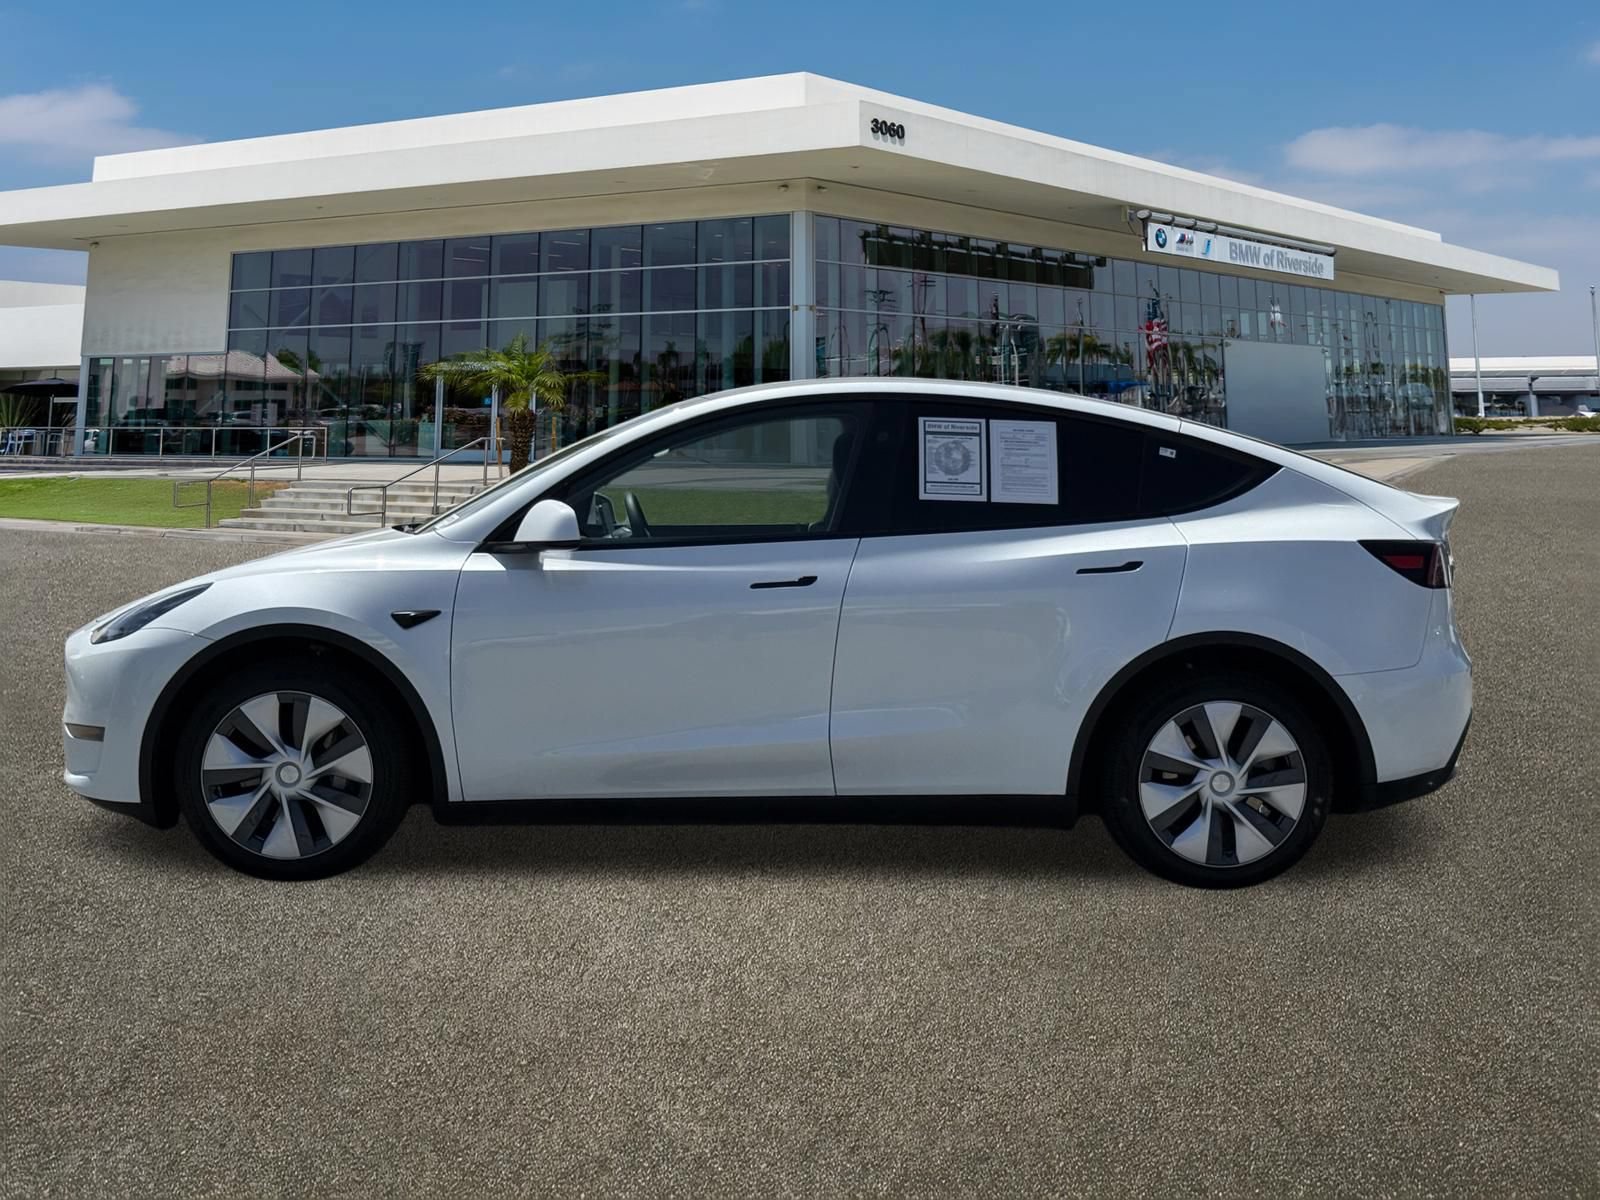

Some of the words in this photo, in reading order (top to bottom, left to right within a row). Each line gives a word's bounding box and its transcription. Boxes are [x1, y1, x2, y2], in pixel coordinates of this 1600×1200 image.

[870, 118, 905, 140] 3060
[1229, 242, 1261, 265] BMW
[1262, 249, 1275, 268] of
[1276, 250, 1325, 275] Riverside
